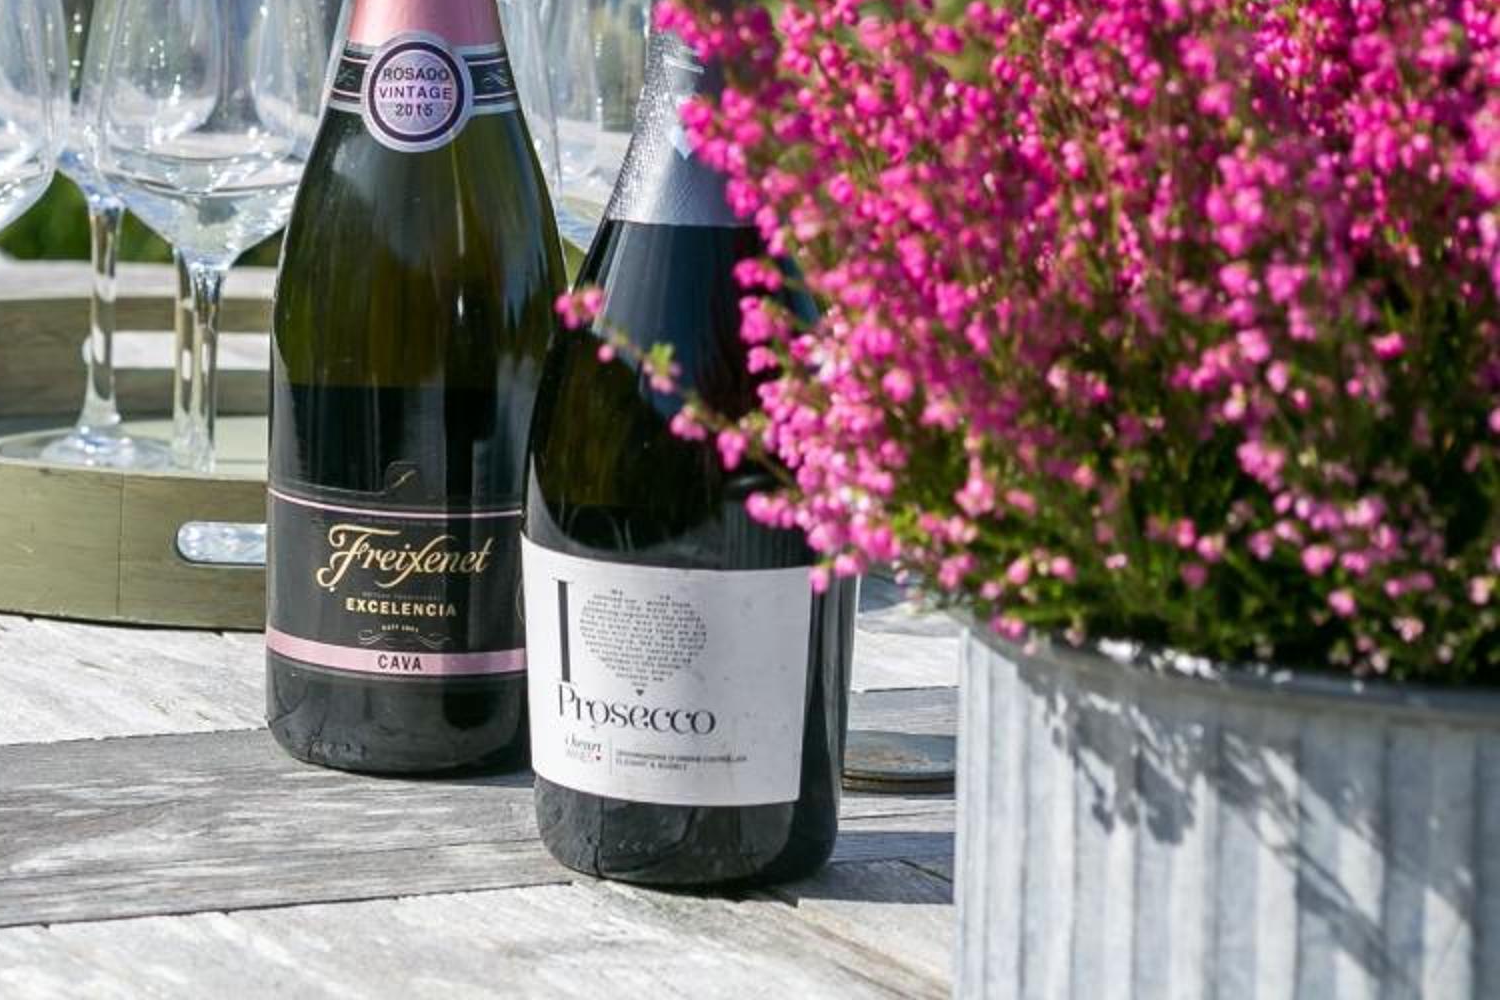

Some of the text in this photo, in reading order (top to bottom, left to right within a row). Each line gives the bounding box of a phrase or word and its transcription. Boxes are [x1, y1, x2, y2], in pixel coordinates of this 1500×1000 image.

[383, 67, 449, 80] ROSADO
[379, 85, 452, 100] VINTAGE
[315, 522, 494, 589] Freixenet
[345, 597, 457, 617] EXCELENCIA
[377, 653, 423, 672] CAVA
[559, 684, 716, 734] Prosecco
